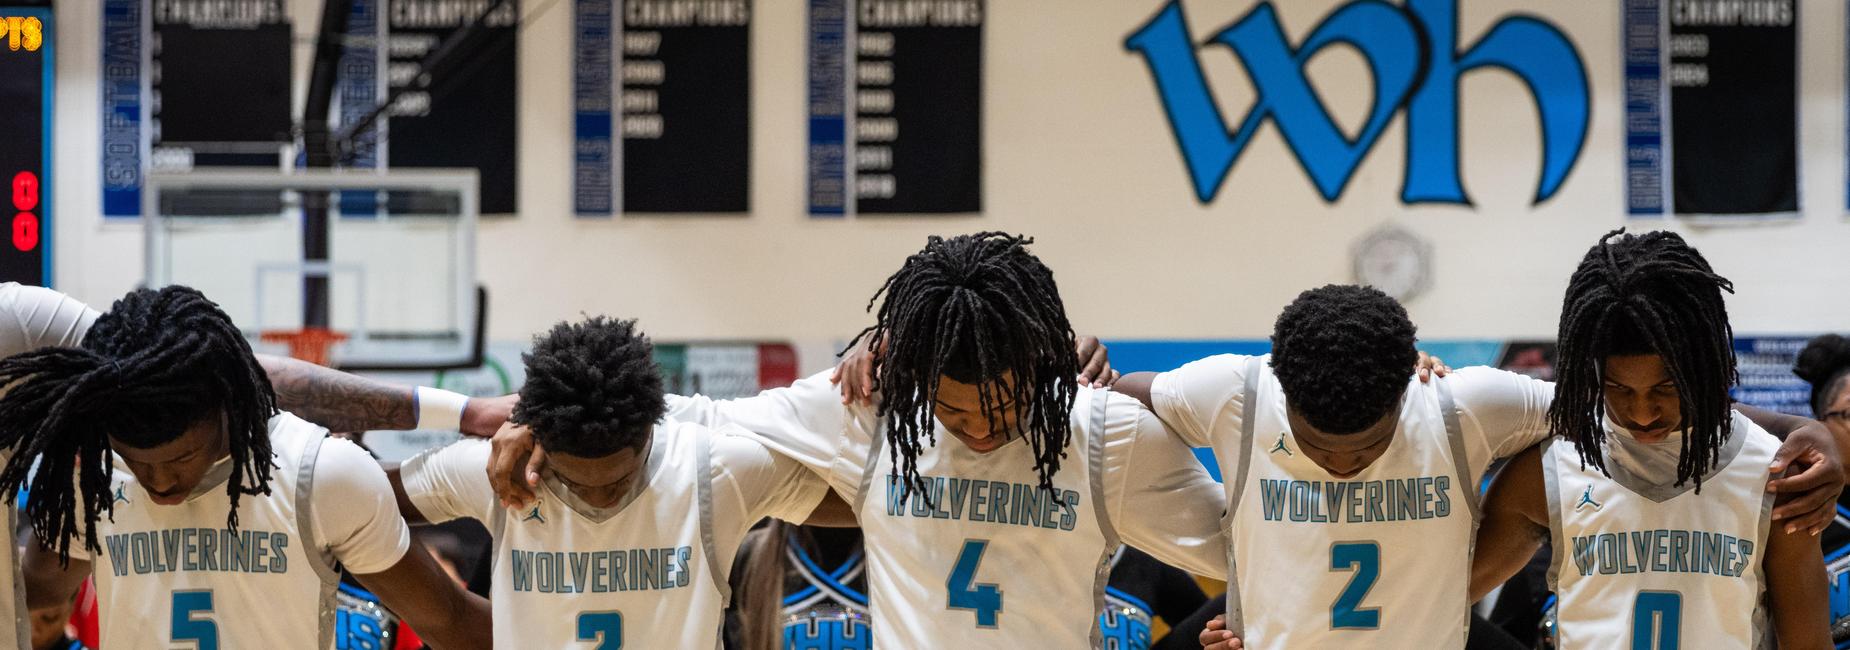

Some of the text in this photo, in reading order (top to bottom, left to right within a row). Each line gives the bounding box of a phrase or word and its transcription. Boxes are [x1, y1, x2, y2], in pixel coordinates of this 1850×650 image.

[624, 0, 749, 27] CHAMPIONS
[857, 0, 983, 27] CHAMPIONS
[1671, 0, 1793, 26] CHAMPIONS
[886, 474, 1080, 531] WOLVERINES
[1260, 475, 1450, 523] WOLVERINES
[105, 528, 288, 576] WOLVERINES
[511, 546, 692, 594] WOLVERINES
[1572, 529, 1754, 577] WOLVERINES
[945, 539, 1004, 629] 4
[1328, 539, 1382, 631] 2
[170, 588, 221, 650] 5
